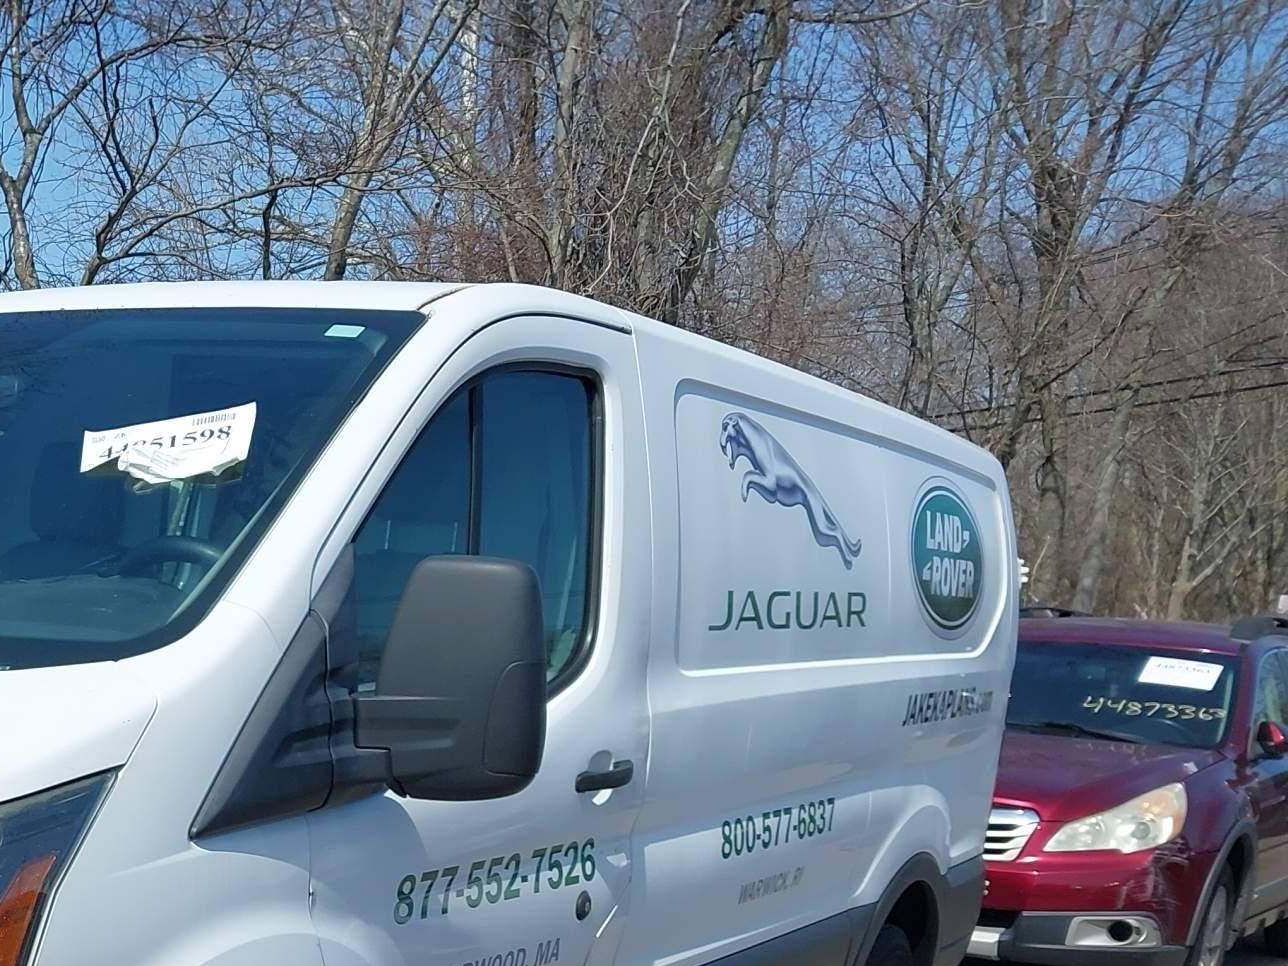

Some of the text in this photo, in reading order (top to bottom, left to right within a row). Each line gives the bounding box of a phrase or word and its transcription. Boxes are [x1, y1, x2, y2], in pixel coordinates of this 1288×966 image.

[925, 509, 963, 553] LAND
[930, 556, 975, 599] ROVER
[707, 590, 868, 631] JAGUAR
[721, 797, 836, 859] 800-577-6837
[393, 837, 596, 925] 877-552-7526
